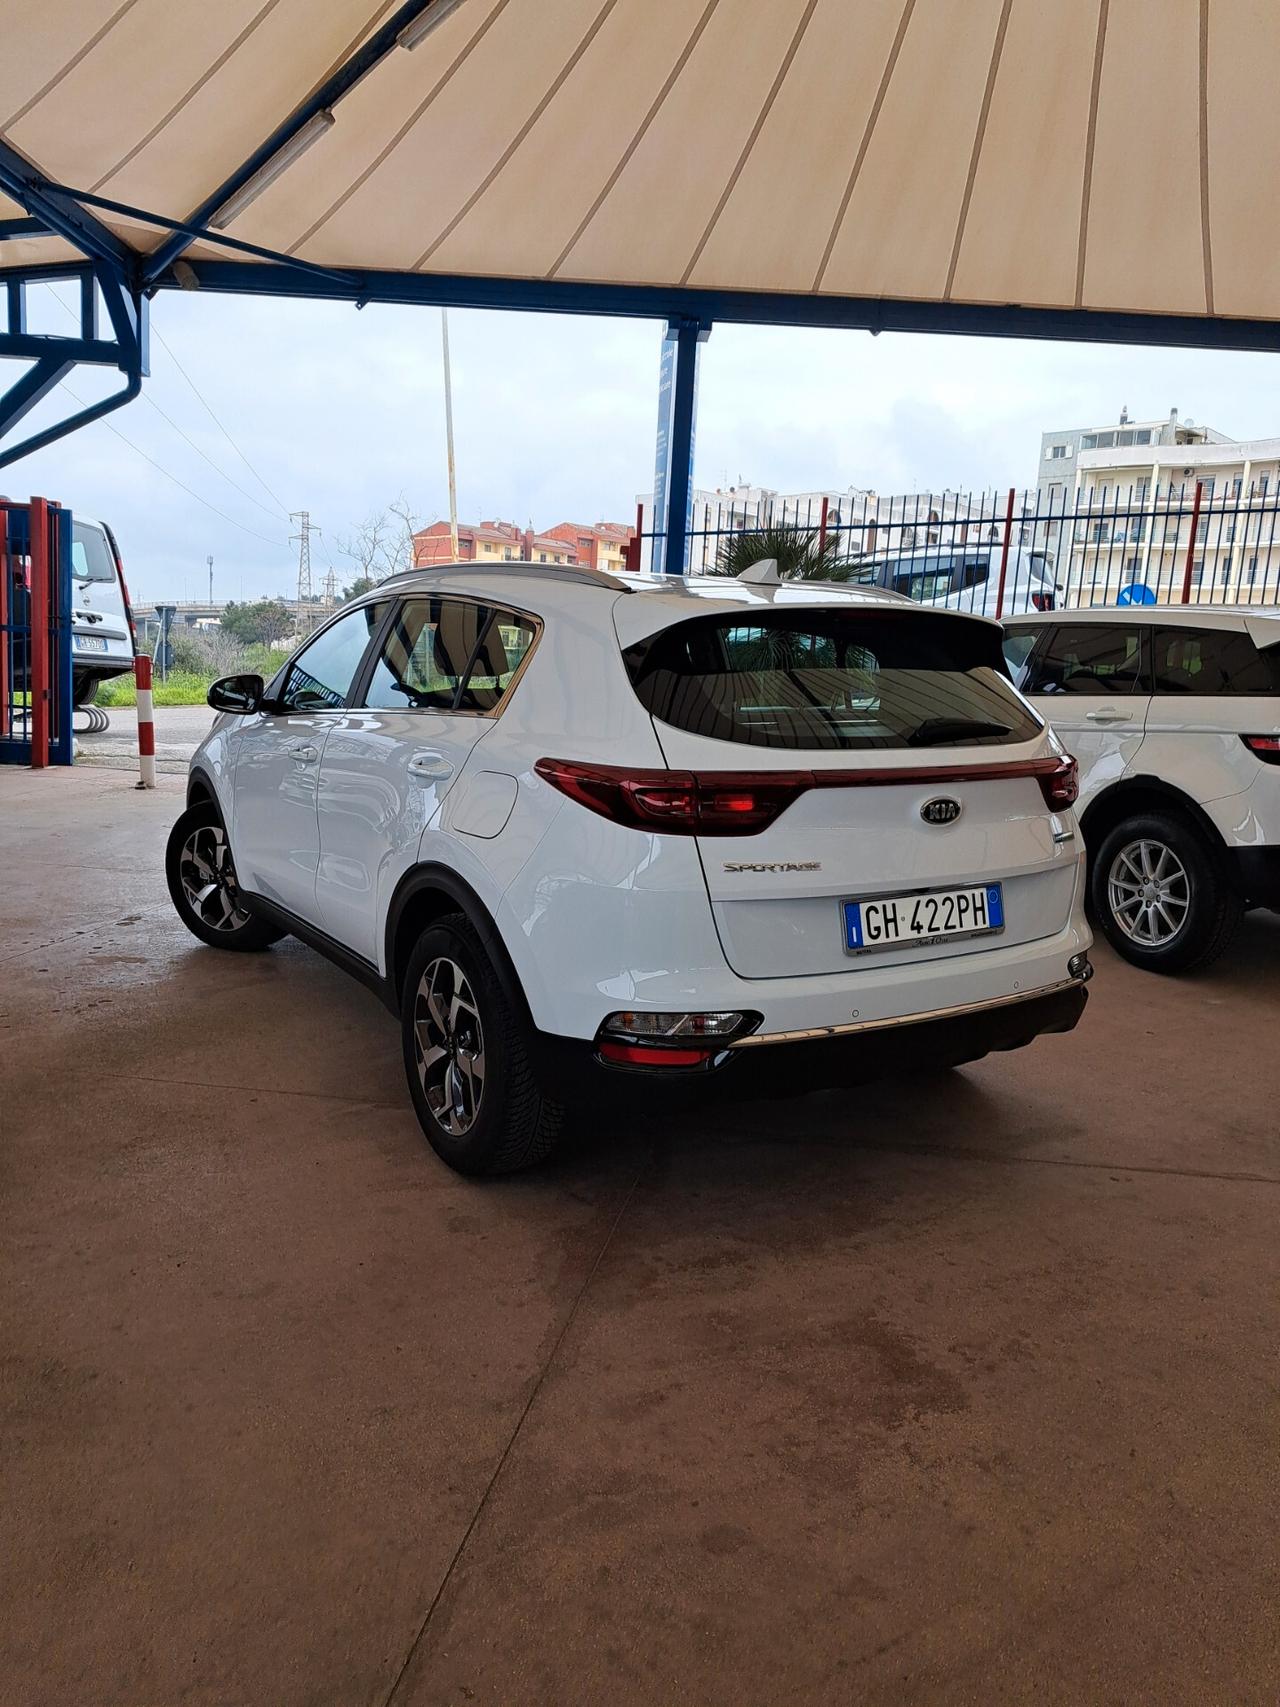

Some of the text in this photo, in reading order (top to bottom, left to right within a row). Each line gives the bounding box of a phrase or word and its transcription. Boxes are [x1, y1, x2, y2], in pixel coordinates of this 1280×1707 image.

[929, 804, 956, 820] KIA
[724, 861, 822, 873] SPORTAGE
[865, 902, 899, 940] GH
[910, 892, 987, 934] 422PH
